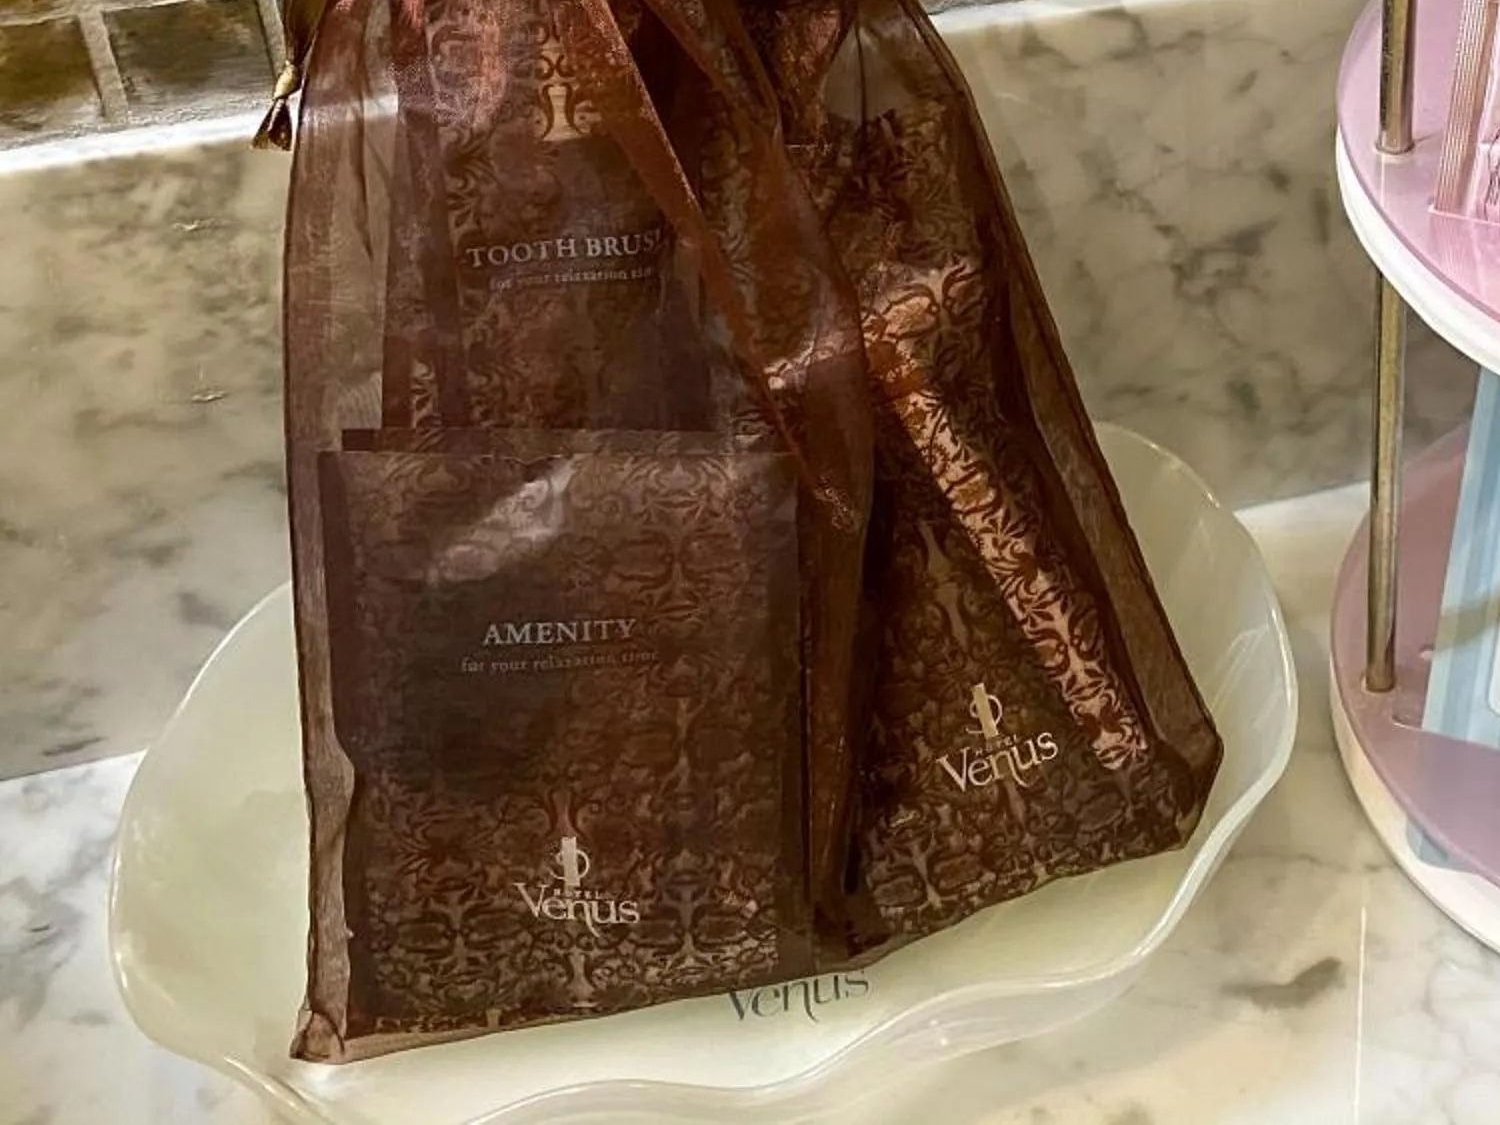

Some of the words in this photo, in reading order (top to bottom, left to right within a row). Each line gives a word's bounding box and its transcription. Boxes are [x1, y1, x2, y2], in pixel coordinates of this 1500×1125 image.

[466, 237, 576, 268] TOOTH
[483, 618, 637, 646] AMENITY
[461, 657, 484, 672] for
[936, 732, 1059, 792] Venus
[513, 882, 641, 938] Venus
